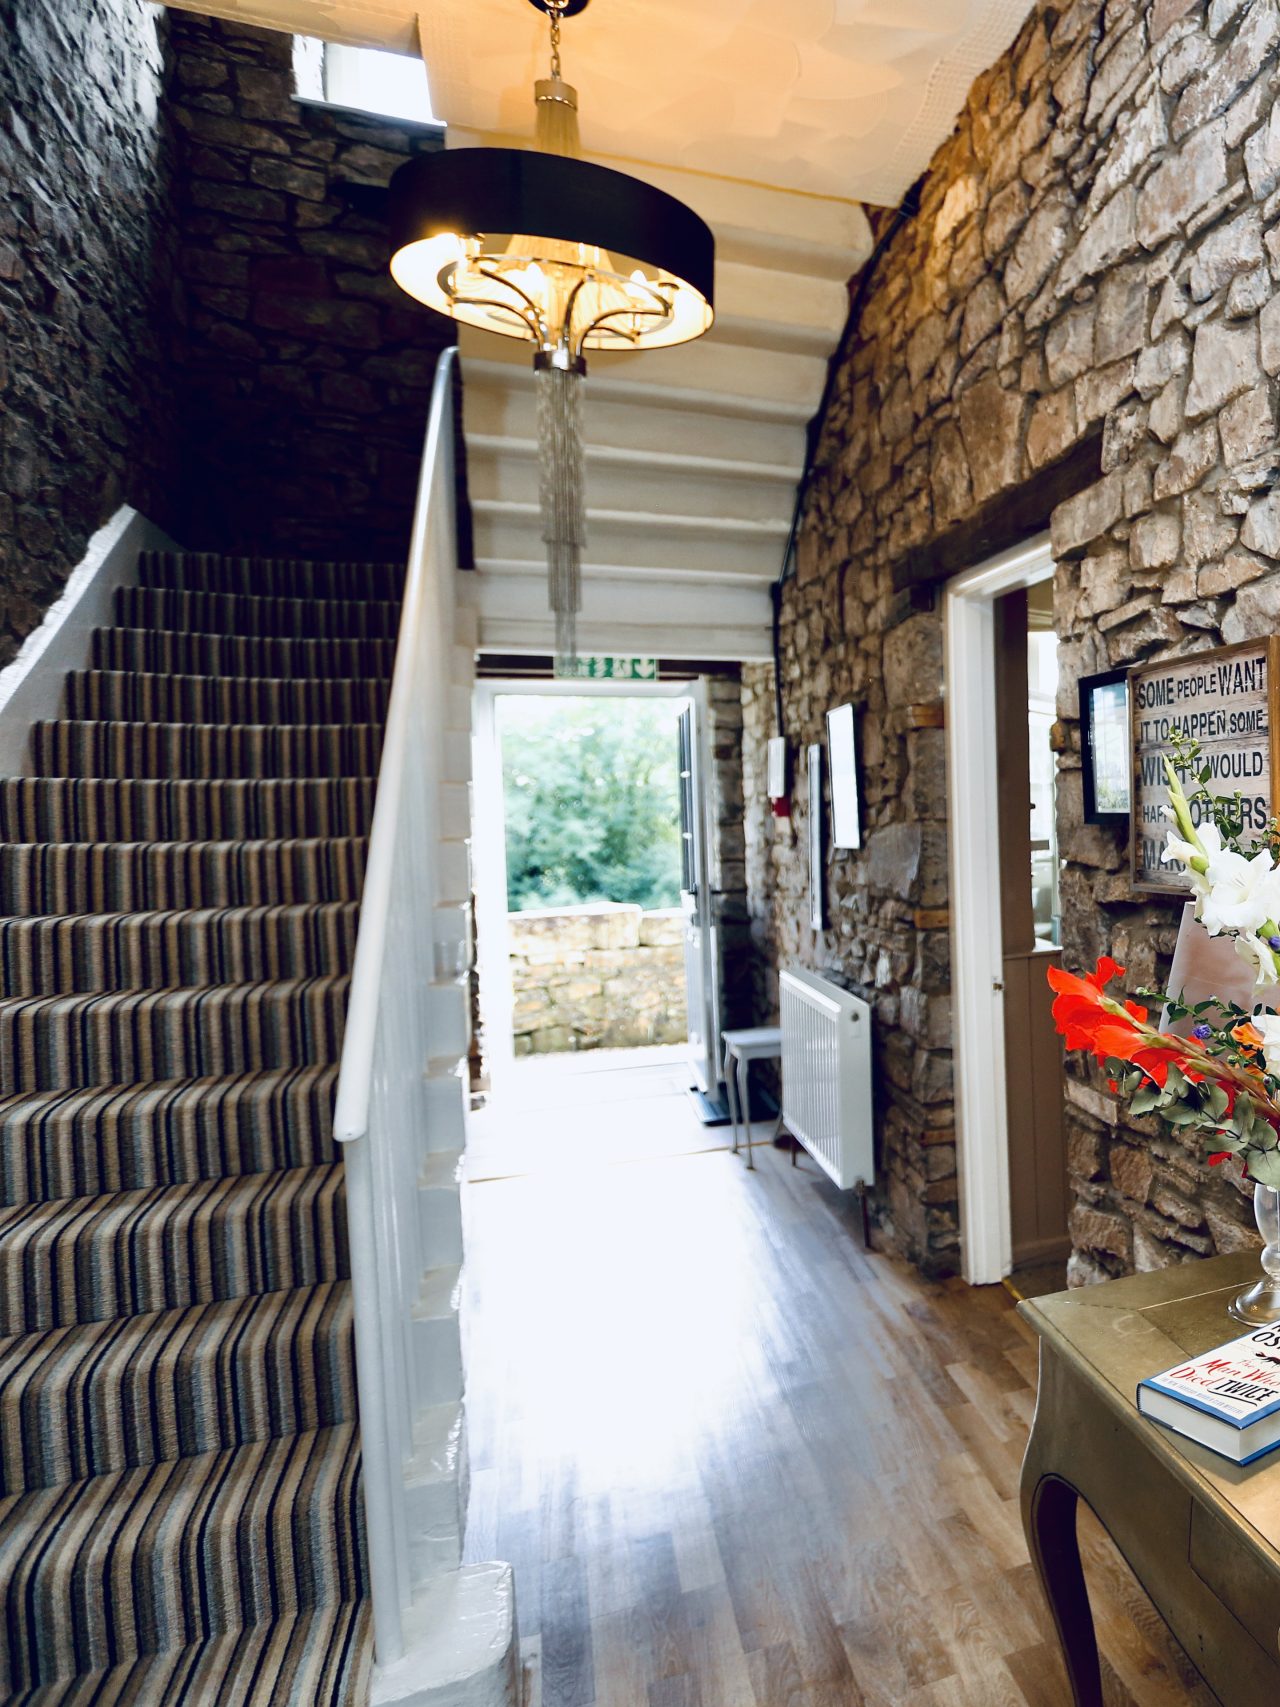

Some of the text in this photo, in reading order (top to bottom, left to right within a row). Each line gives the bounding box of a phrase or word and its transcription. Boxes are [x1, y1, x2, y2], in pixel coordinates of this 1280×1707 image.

[1138, 656, 1266, 710] SOME PEOPLE WANT
[1140, 720, 1151, 744] IT
[1153, 718, 1169, 742] TO
[1229, 709, 1264, 734] SOME
[1206, 751, 1263, 779] WOULD
[1169, 1366, 1226, 1388] Died
[1214, 1379, 1279, 1402] TWICE
[1196, 1358, 1241, 1377] Man
